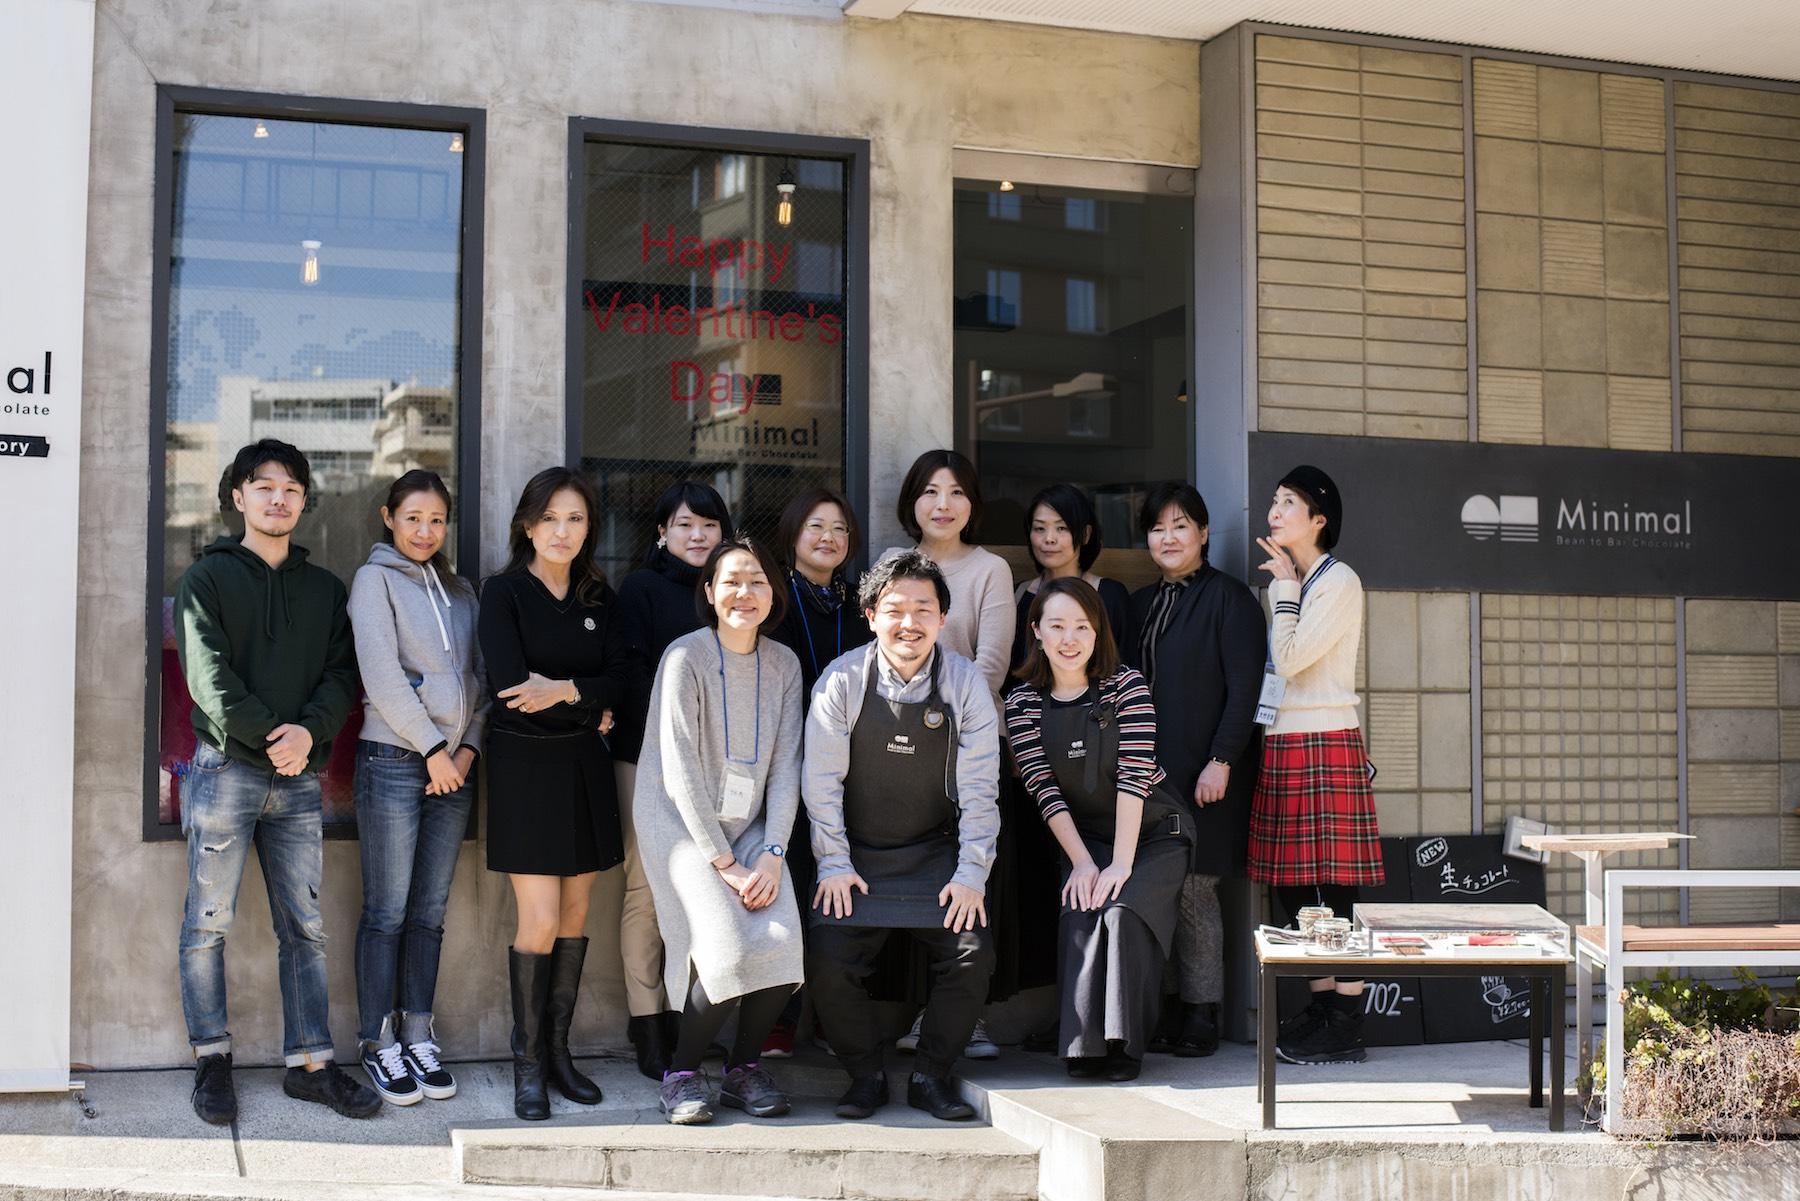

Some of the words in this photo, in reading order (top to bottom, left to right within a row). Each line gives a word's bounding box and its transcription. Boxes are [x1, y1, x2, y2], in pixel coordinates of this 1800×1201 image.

[640, 222, 792, 283] Happy
[585, 290, 843, 345] Valentine's
[669, 360, 762, 415] Day
[690, 418, 818, 446] Minimal
[1557, 497, 1691, 535] Minimal
[887, 743, 915, 752] Minimal
[1420, 840, 1446, 864] NEW
